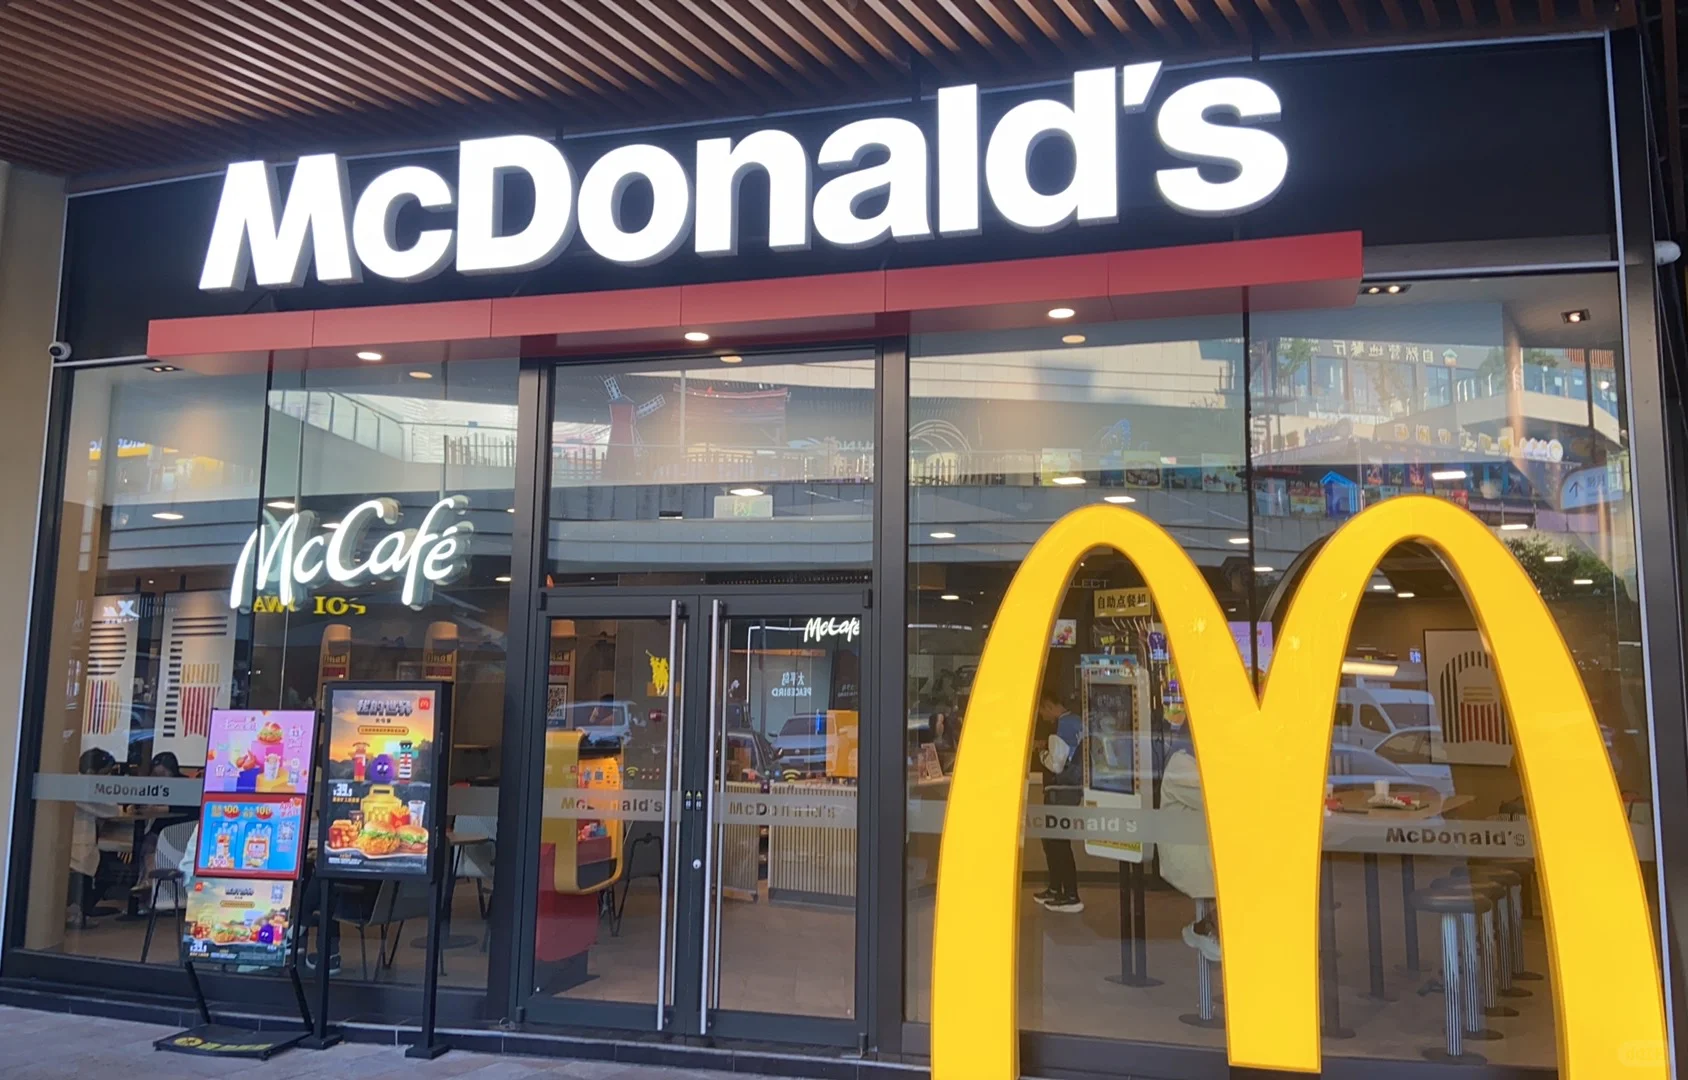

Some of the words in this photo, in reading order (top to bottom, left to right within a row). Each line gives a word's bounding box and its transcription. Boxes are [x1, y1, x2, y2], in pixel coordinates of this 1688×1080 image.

[199, 61, 1289, 292] McDonald's
[230, 496, 466, 609] McCafé
[1097, 593, 1147, 610] 自助点餐机
[94, 783, 170, 797] McDonald's
[561, 796, 663, 813] Mcnald's
[1385, 827, 1526, 847] McDonald's
